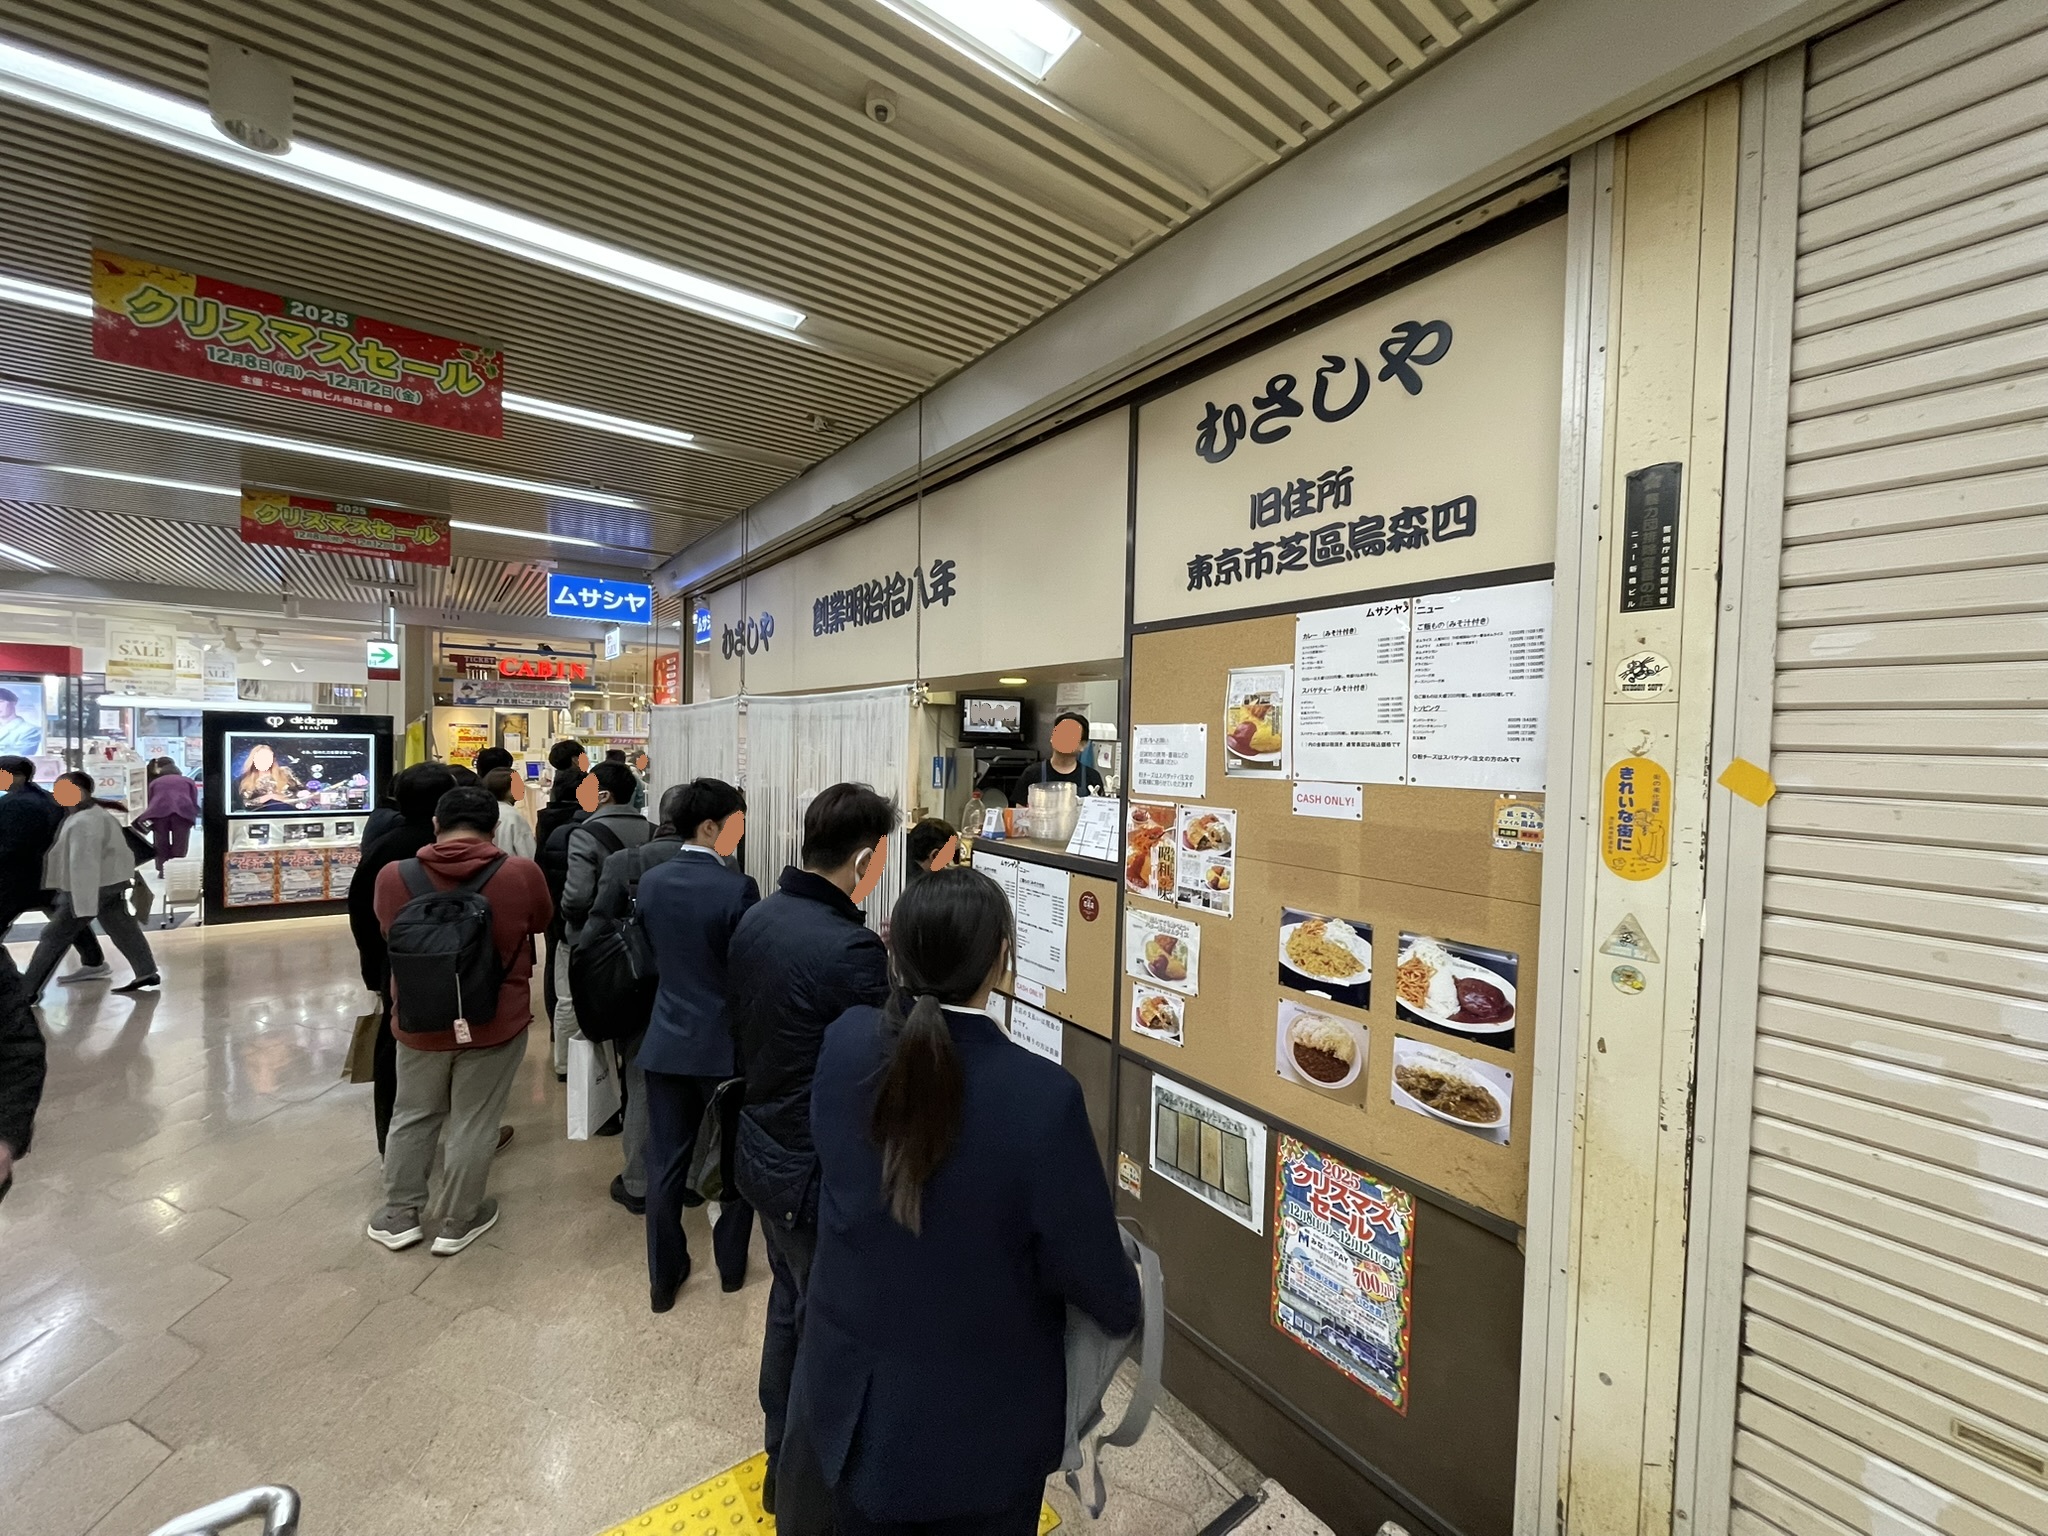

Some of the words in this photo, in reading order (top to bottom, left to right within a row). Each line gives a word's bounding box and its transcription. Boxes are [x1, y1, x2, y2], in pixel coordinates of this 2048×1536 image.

[290, 300, 348, 328] 2025
[126, 284, 486, 397] クリスマスセール
[1195, 319, 1453, 463] むさしや
[336, 503, 367, 515] 2025
[1250, 465, 1354, 529] 旧住所
[255, 504, 440, 546] クリスマスセール
[1627, 531, 1640, 608] ニュー新橋ビル
[555, 585, 646, 612] ムサシヤ
[812, 559, 957, 637] 創業明治拾八年
[119, 644, 166, 658] SALE
[722, 611, 775, 660] むさしや
[465, 656, 496, 664] TICKET
[500, 657, 588, 680] CABIN
[1297, 794, 1322, 804] CASH
[1324, 795, 1355, 807] ONLY!
[1616, 767, 1635, 851] きれいな街に
[1290, 1162, 1399, 1235] クリスマス
[1322, 1158, 1361, 1191] 2025
[1306, 1190, 1376, 1242] セール
